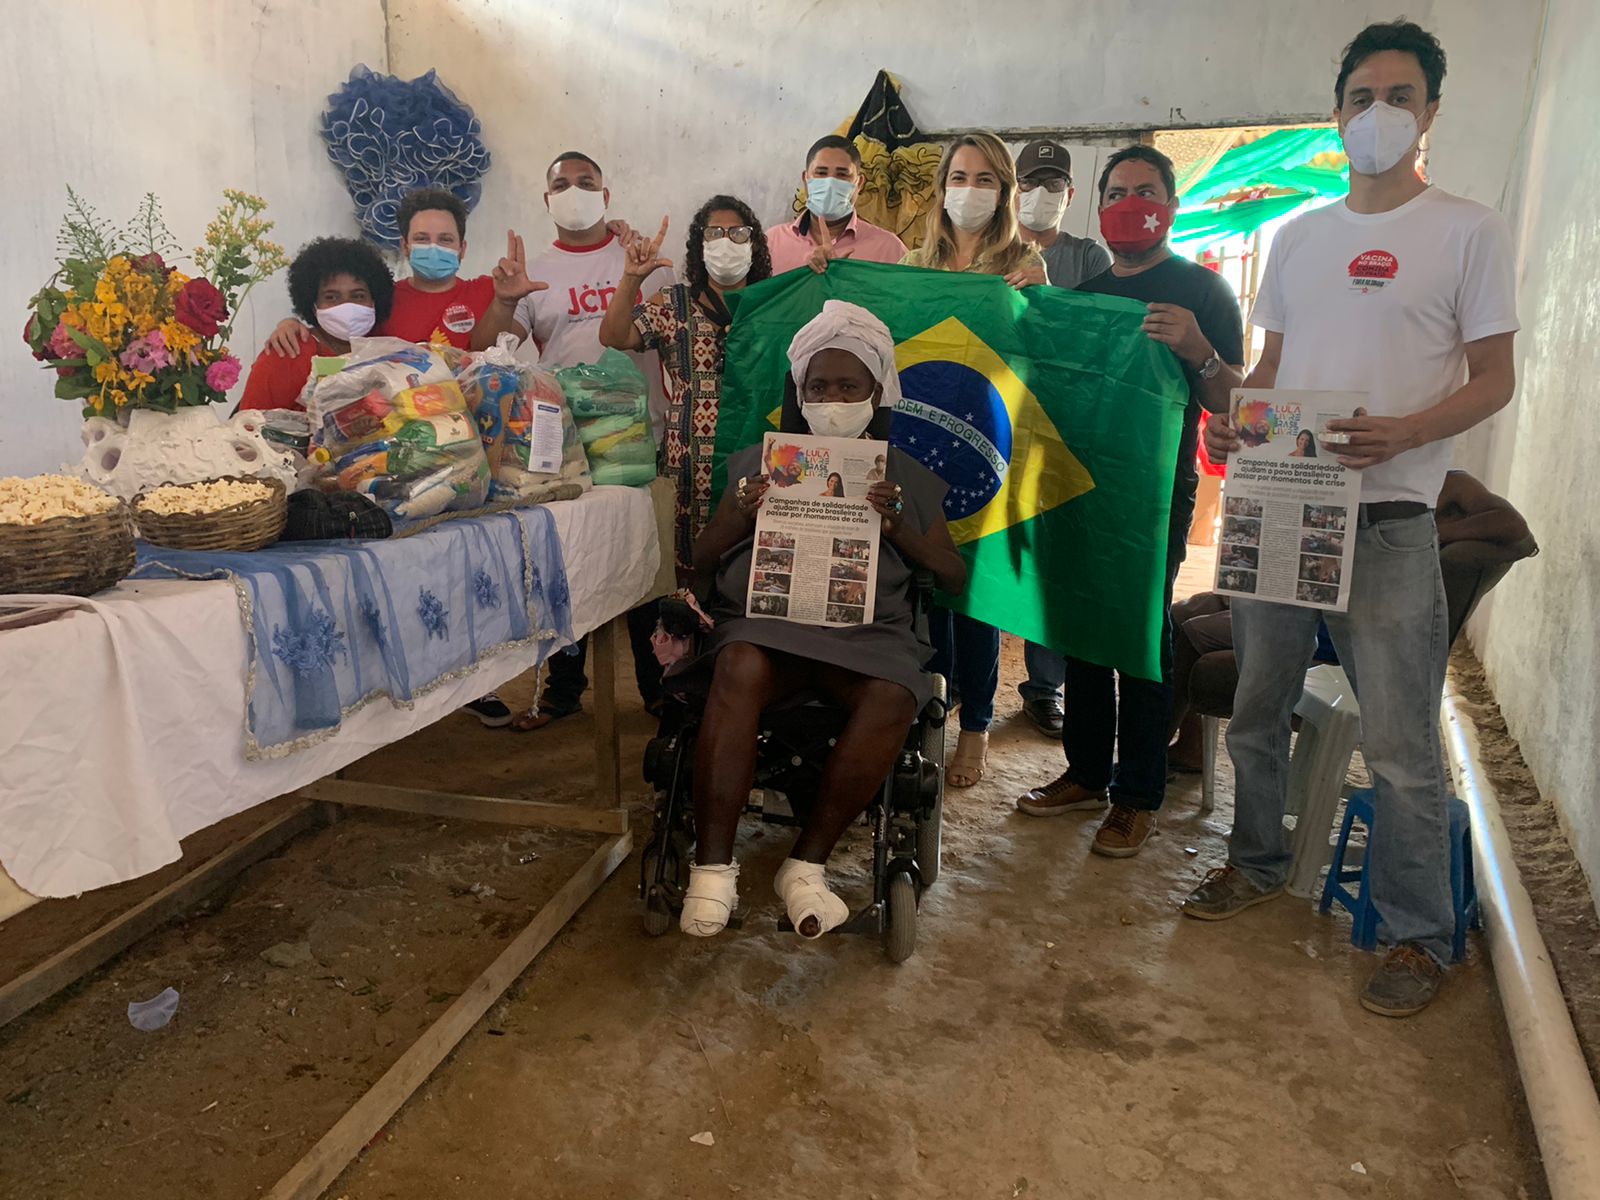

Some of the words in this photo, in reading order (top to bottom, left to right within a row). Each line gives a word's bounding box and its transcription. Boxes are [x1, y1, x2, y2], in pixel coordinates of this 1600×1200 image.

[1275, 405, 1301, 415] LULA
[894, 399, 923, 416] DEM
[929, 410, 937, 421] E
[939, 415, 1005, 472] PROGRESSO
[805, 449, 830, 458] LULA
[1236, 457, 1278, 468] Campanhas
[1290, 462, 1346, 473] solidariedade
[1233, 472, 1257, 480] passar
[1257, 474, 1270, 482] por
[1270, 475, 1312, 485] momentos
[1240, 466, 1267, 474] ajudam
[1294, 470, 1331, 479] brasileiro
[768, 496, 810, 507] Campanhas
[822, 502, 869, 511] solidariedade
[773, 504, 799, 512] ajudam
[825, 508, 857, 517] brasileiro
[803, 513, 840, 521] momentos
